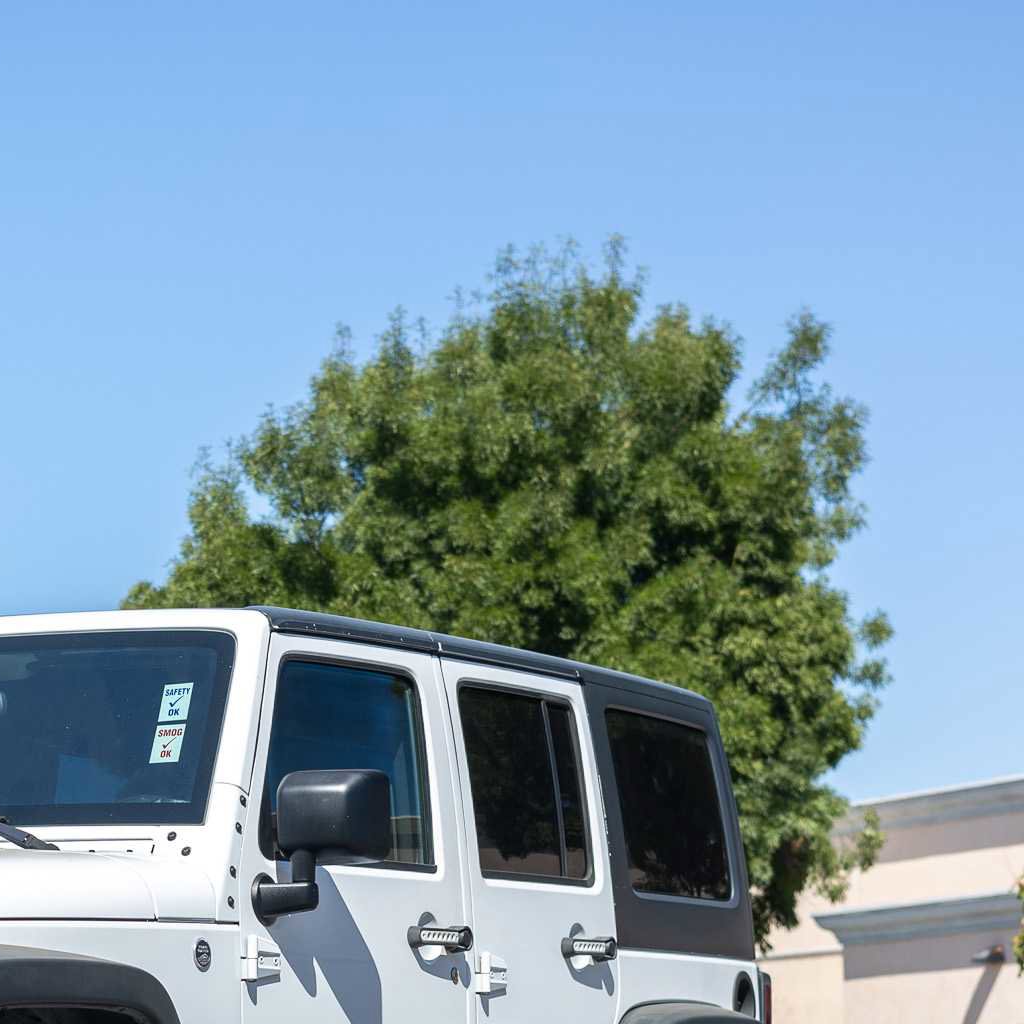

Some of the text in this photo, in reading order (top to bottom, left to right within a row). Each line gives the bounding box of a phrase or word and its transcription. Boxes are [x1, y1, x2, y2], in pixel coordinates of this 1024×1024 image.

[165, 688, 191, 696] SAFETY
[168, 708, 180, 716] OK
[157, 729, 183, 737] SMOG
[160, 750, 172, 758] OK
